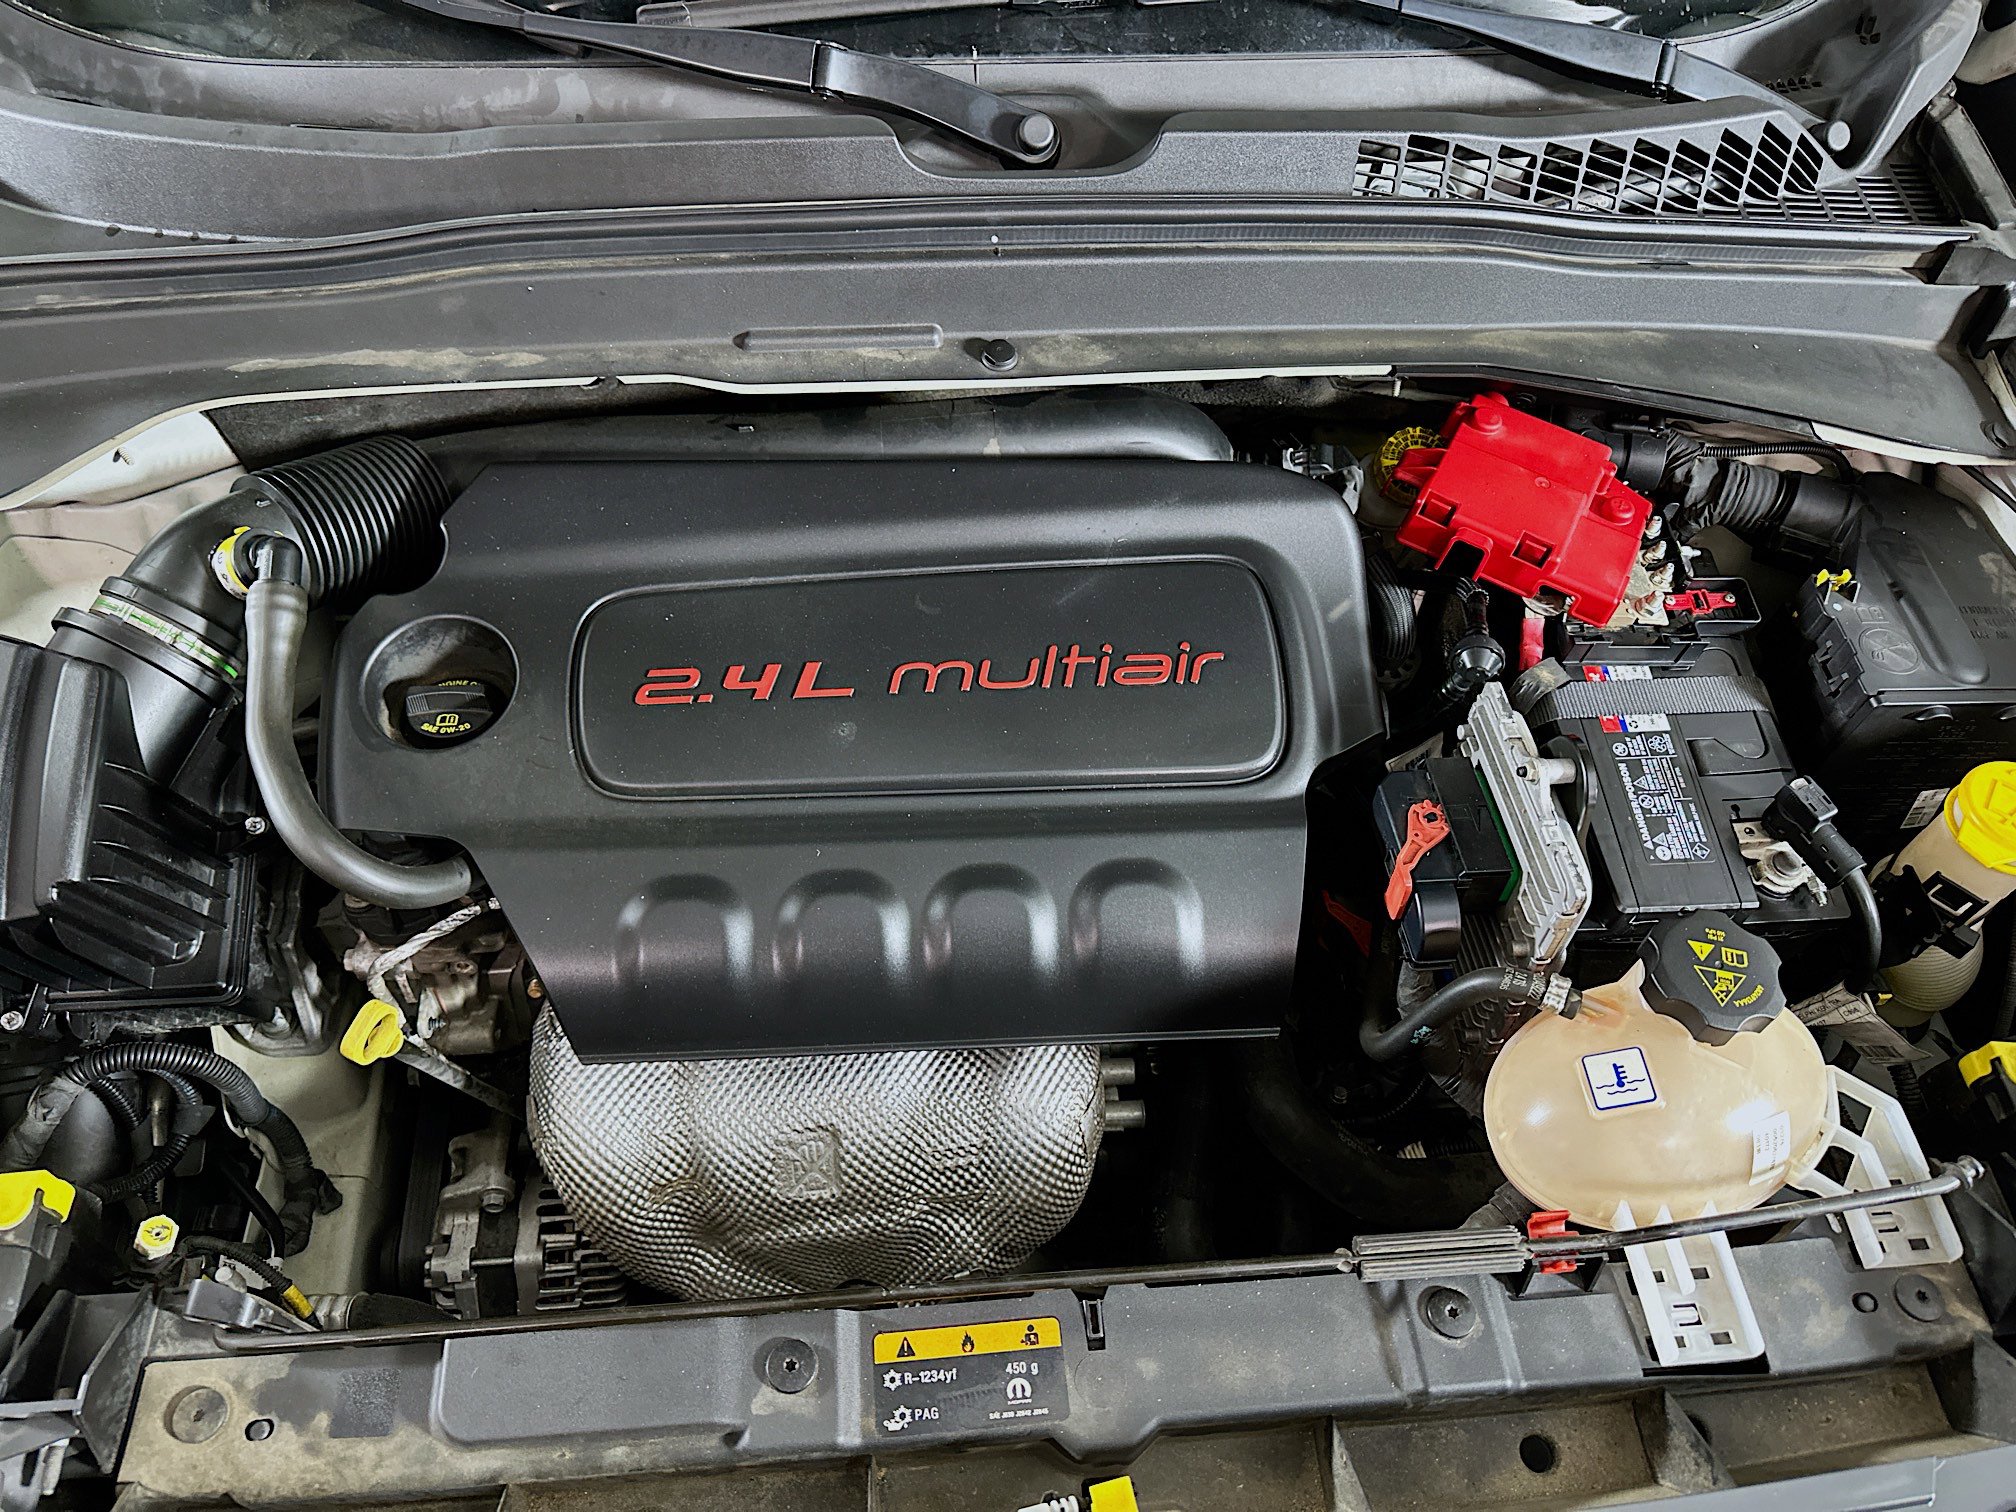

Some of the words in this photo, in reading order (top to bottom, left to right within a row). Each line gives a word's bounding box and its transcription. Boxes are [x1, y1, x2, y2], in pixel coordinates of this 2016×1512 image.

[889, 641, 1225, 695] multiair
[420, 722, 440, 733] SAE
[439, 722, 471, 734] 0W-20
[903, 1367, 958, 1385] R-1234yf
[1005, 1361, 1027, 1375] 450
[1030, 1362, 1039, 1376] g
[914, 1406, 940, 1421] PAG
